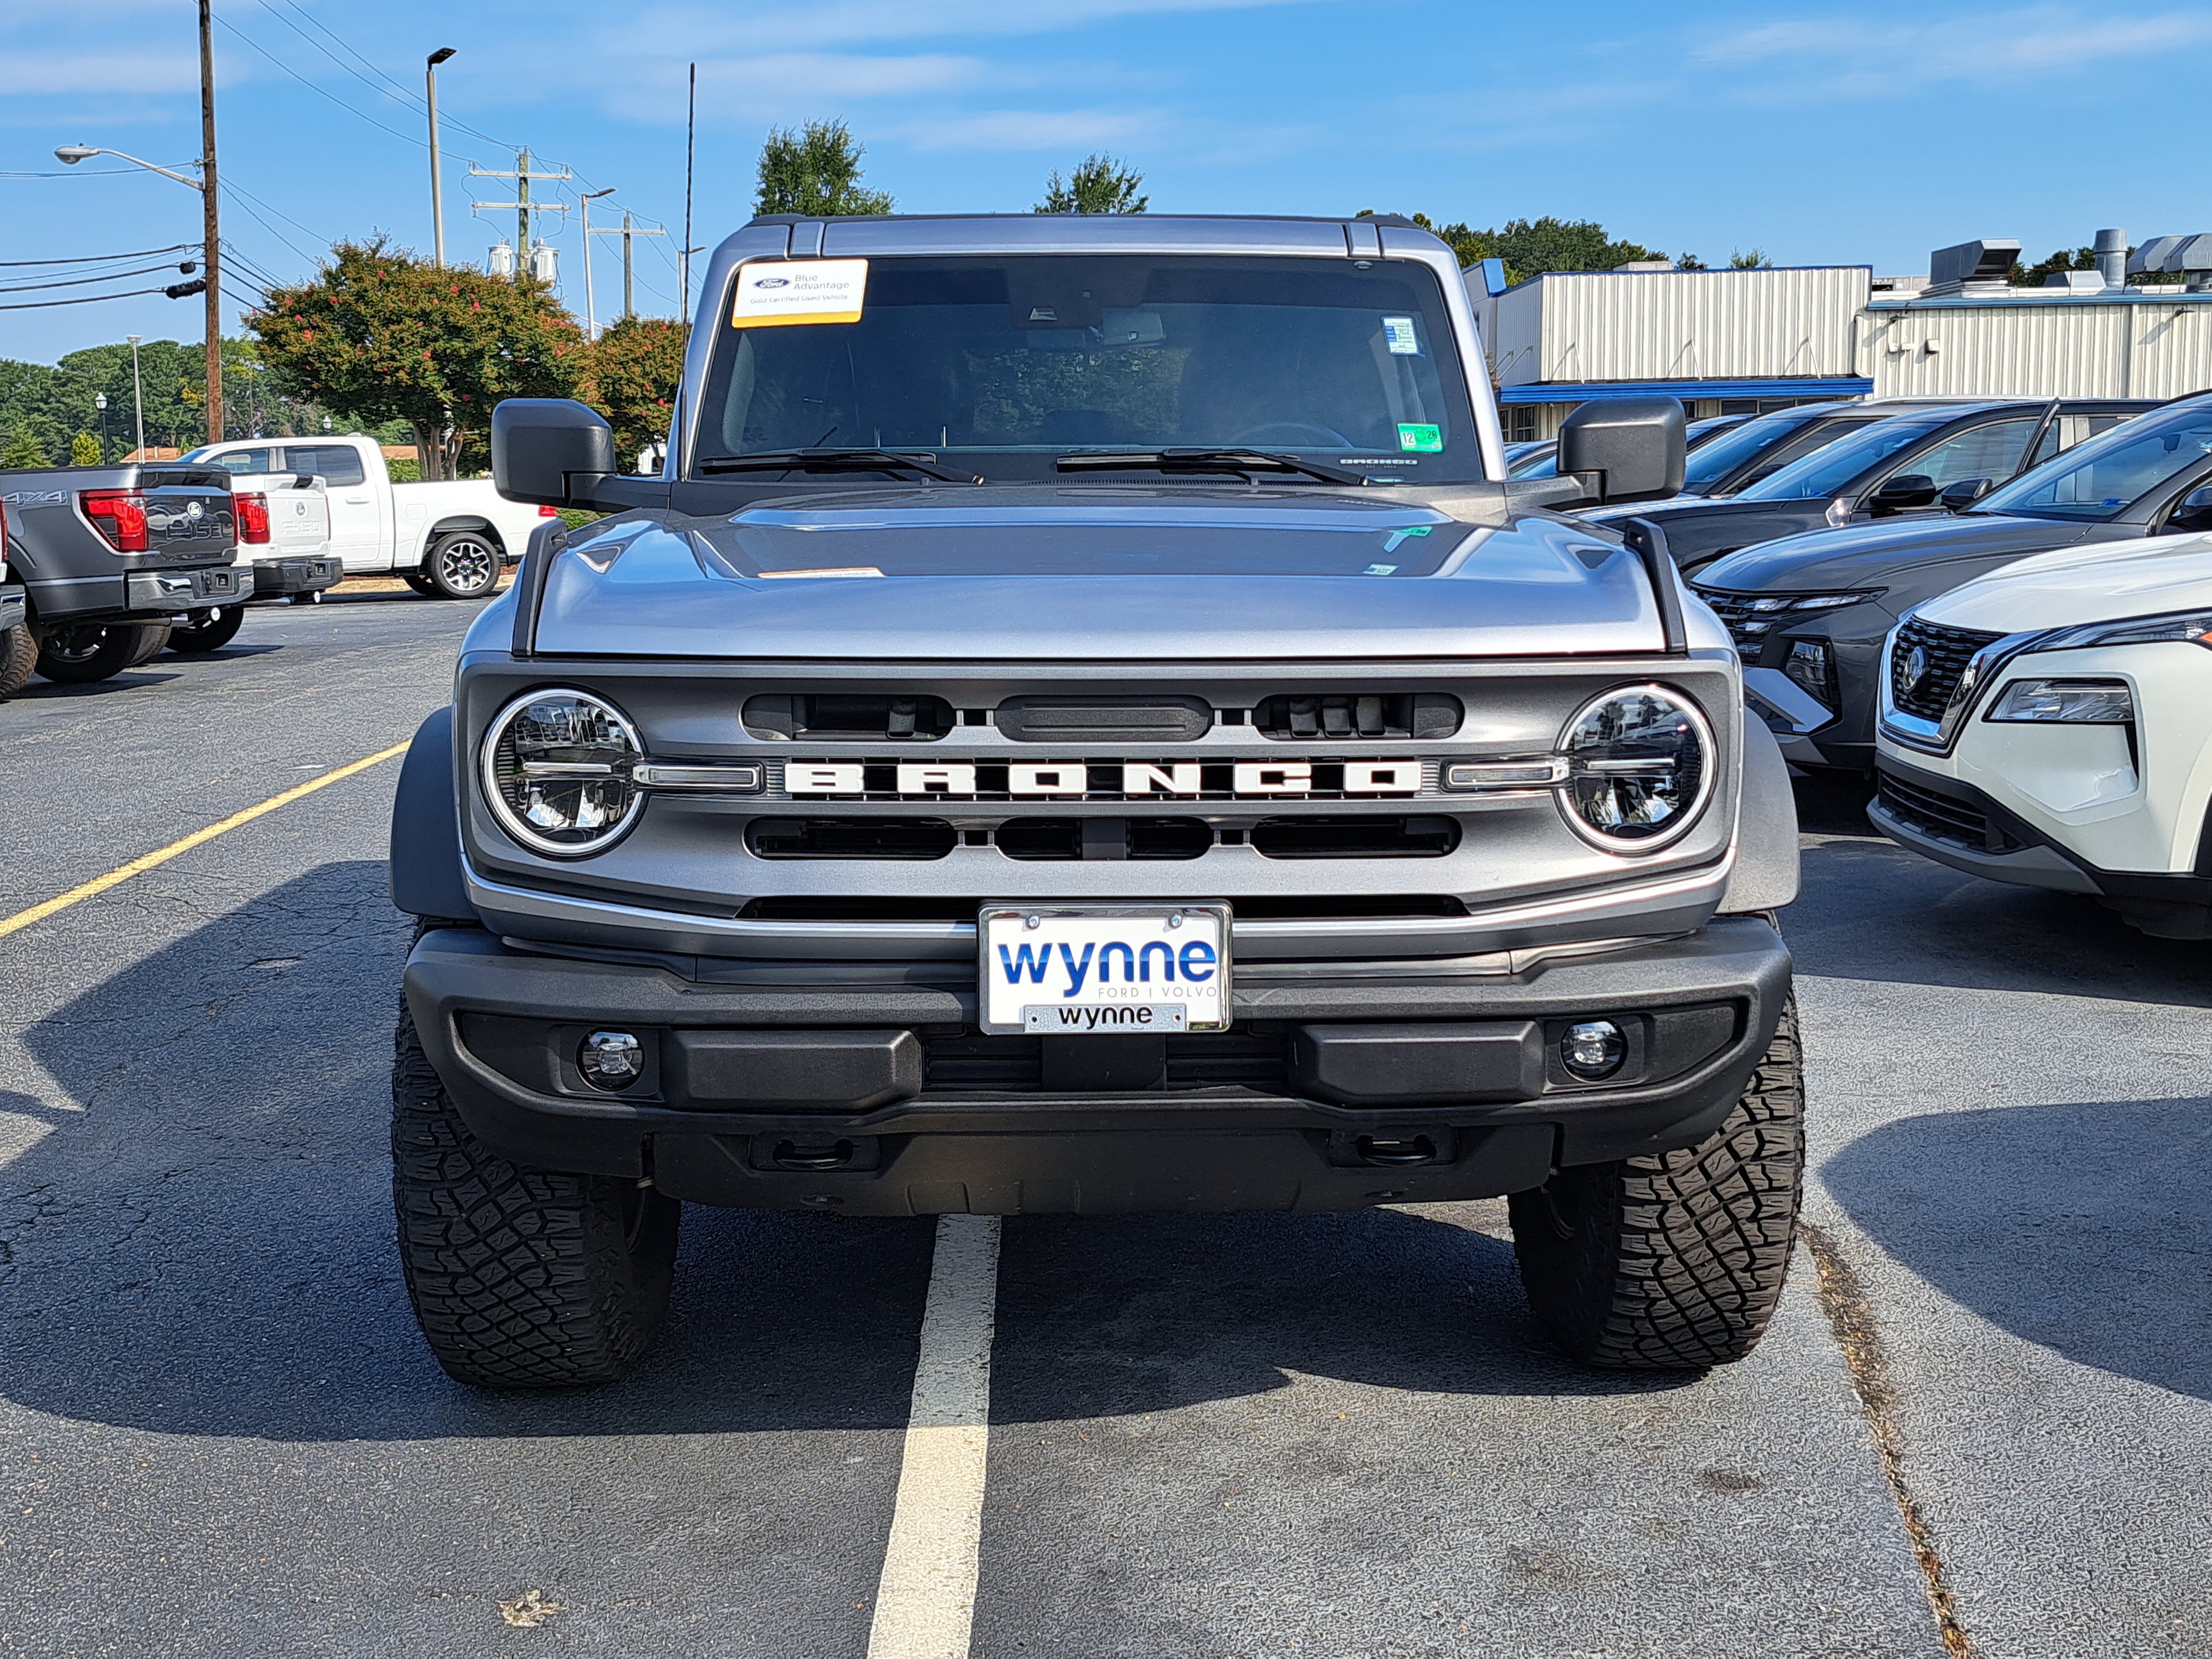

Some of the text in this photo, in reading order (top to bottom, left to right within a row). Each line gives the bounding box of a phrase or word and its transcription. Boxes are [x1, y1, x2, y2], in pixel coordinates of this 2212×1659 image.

[758, 278, 786, 288] Ford
[1403, 432, 1414, 443] 12
[784, 762, 1424, 795] BRONCO
[997, 940, 1217, 998] wynne
[1098, 986, 1217, 998] FORD VOLVO
[1058, 1006, 1153, 1029] wynne
